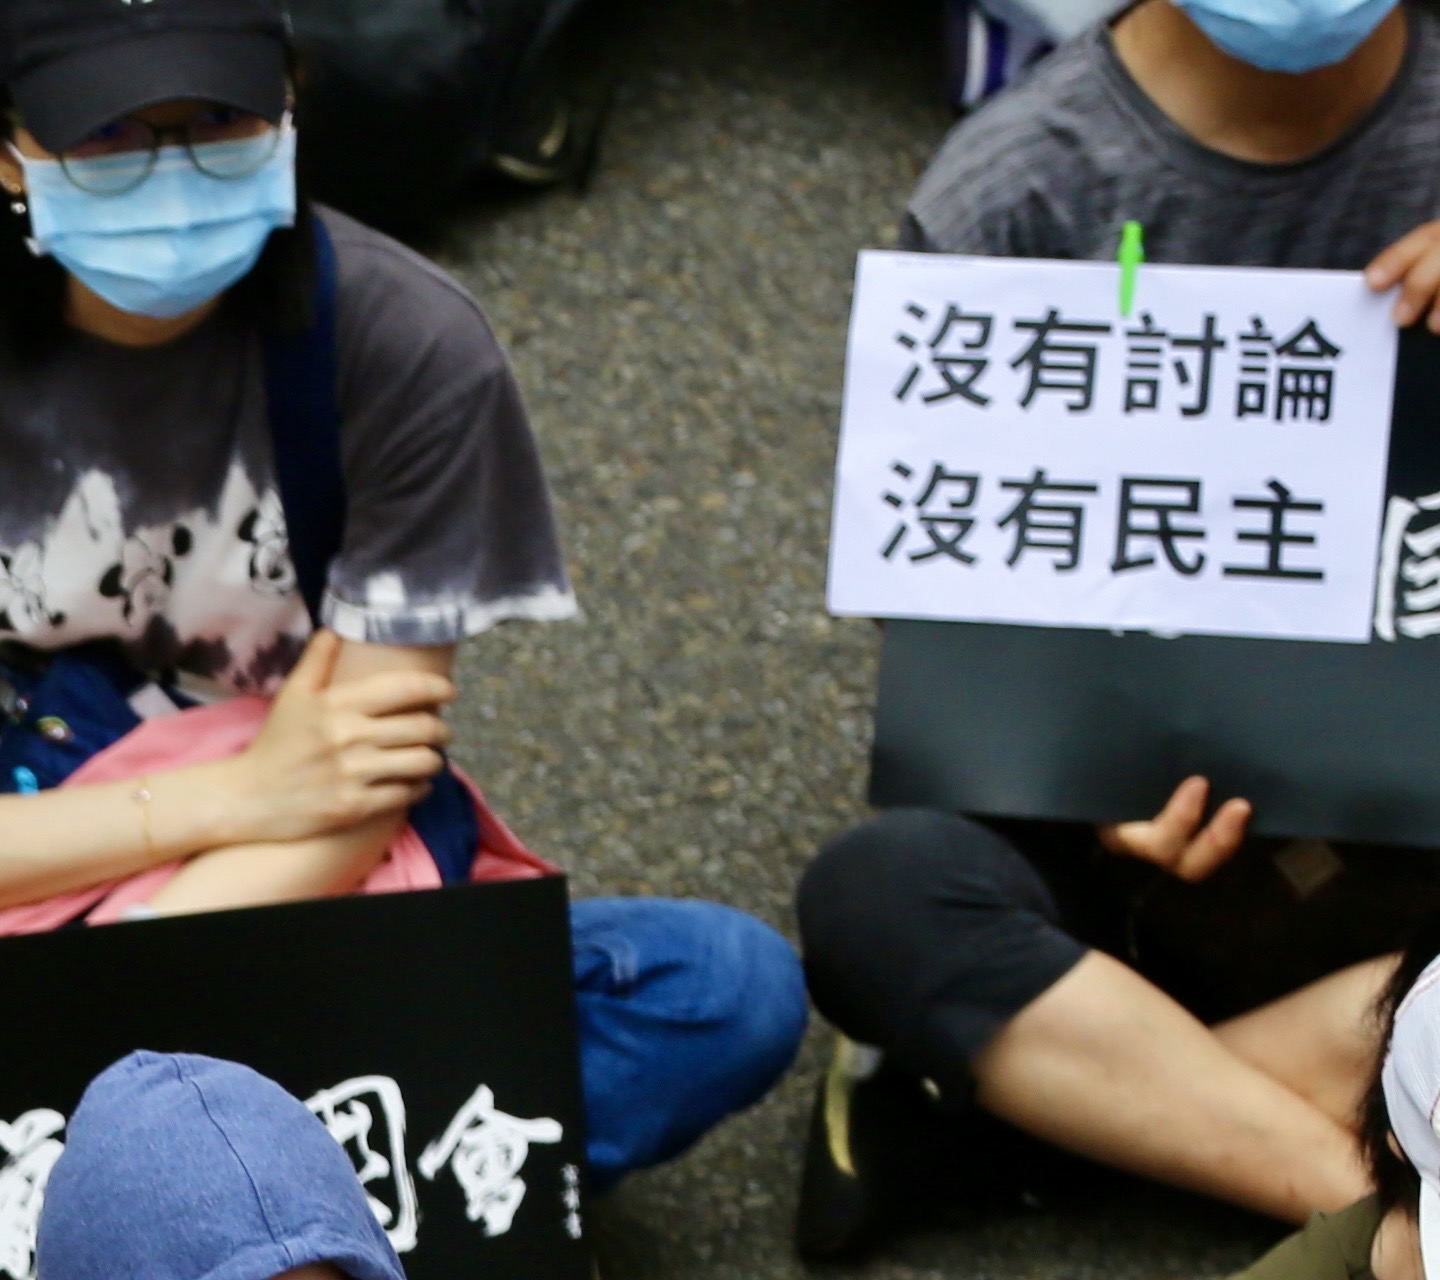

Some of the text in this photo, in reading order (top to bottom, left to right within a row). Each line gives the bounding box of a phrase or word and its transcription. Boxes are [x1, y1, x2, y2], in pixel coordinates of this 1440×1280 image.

[893, 301, 1344, 424] 沒有討論
[880, 461, 1325, 584] 沒有民主
